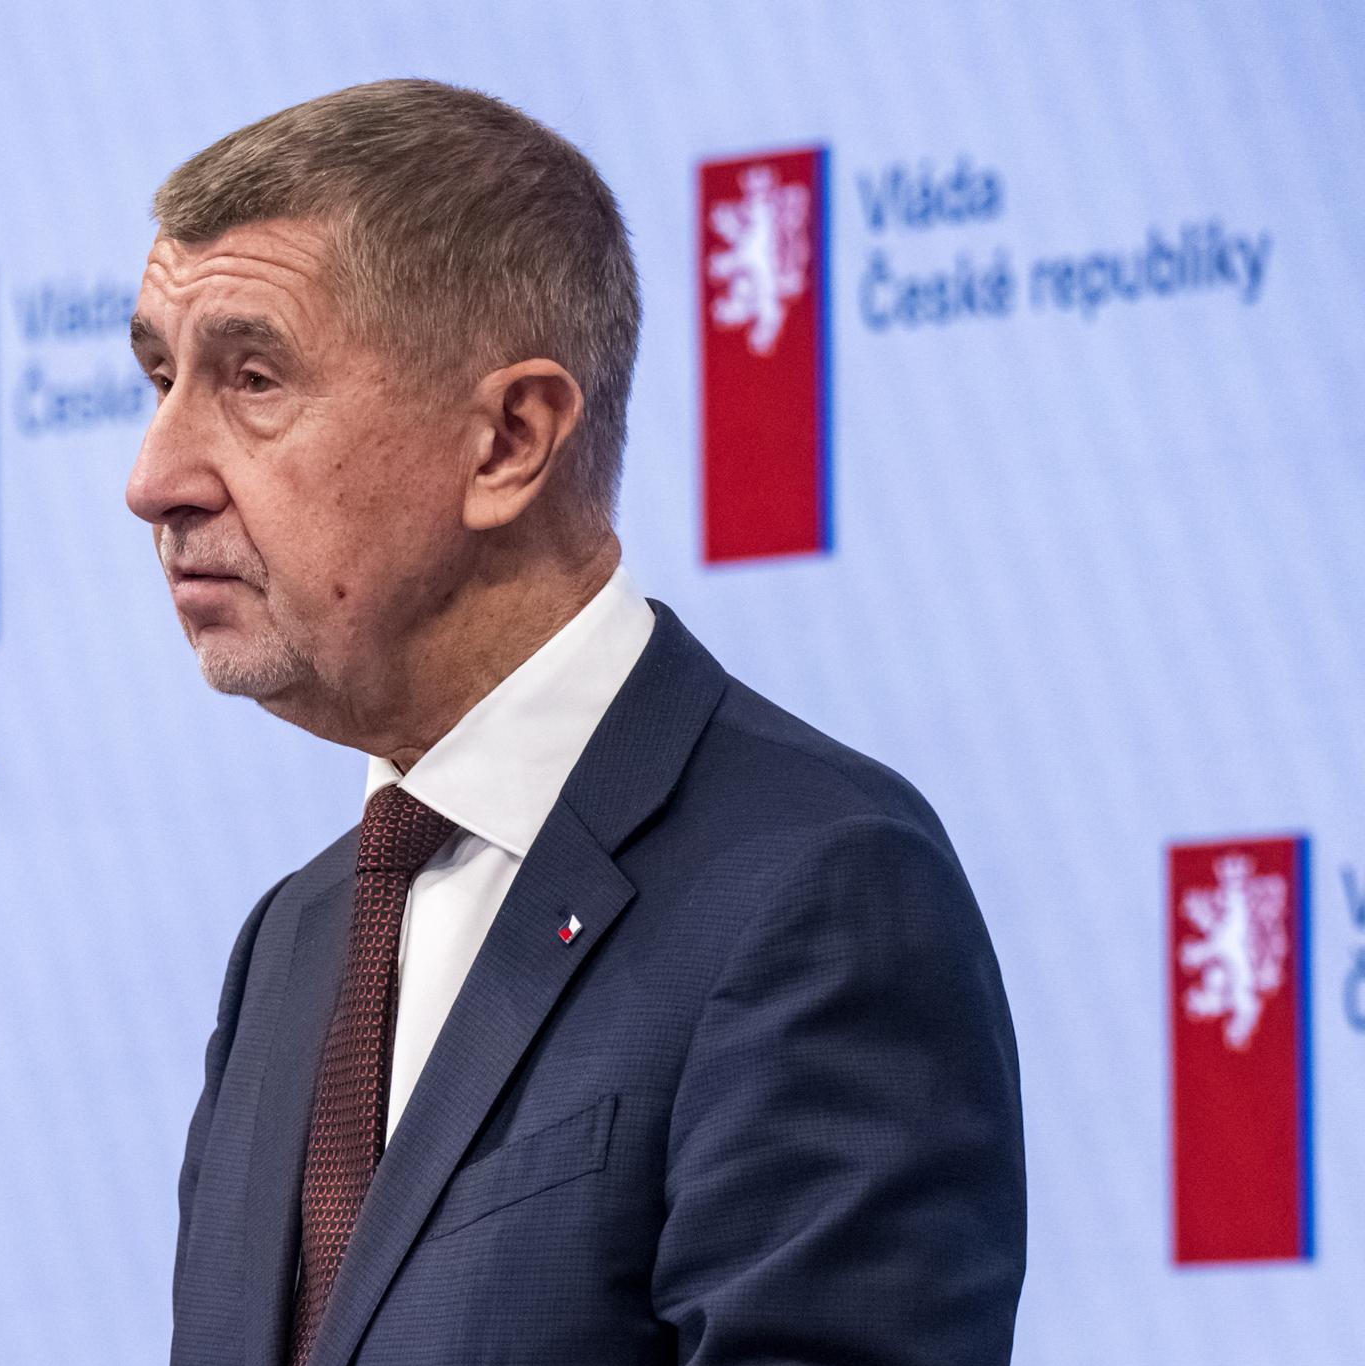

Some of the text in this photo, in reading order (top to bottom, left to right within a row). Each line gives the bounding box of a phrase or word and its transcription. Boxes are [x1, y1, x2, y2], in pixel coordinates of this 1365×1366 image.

[857, 157, 1005, 235] Vláda
[859, 216, 1273, 333] České republiky
